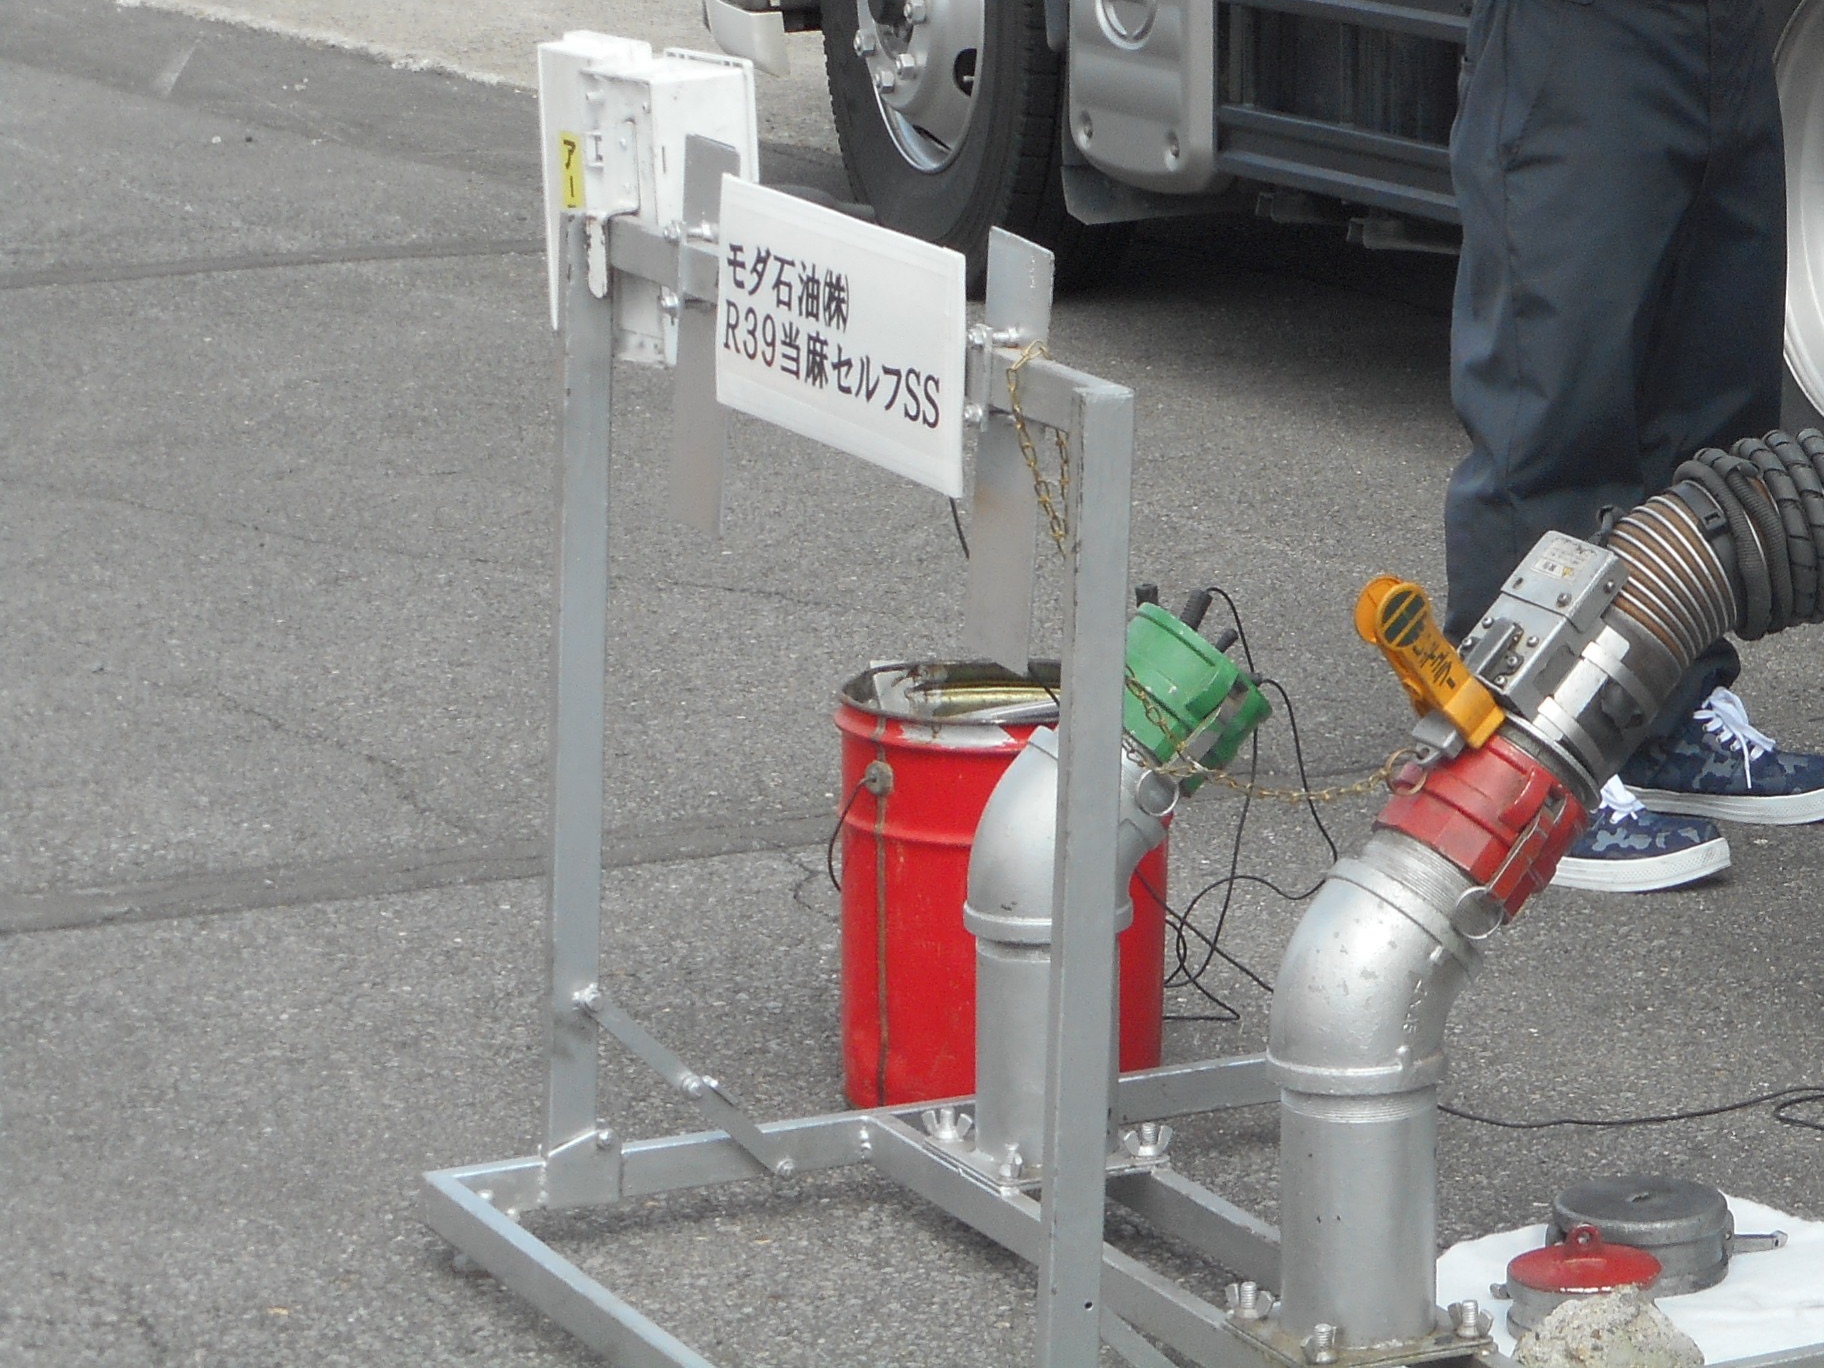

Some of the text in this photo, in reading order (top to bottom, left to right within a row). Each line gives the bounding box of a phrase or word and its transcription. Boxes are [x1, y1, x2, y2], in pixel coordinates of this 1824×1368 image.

[562, 139, 577, 209] アー
[723, 298, 942, 429] R39当麻セルフSS
